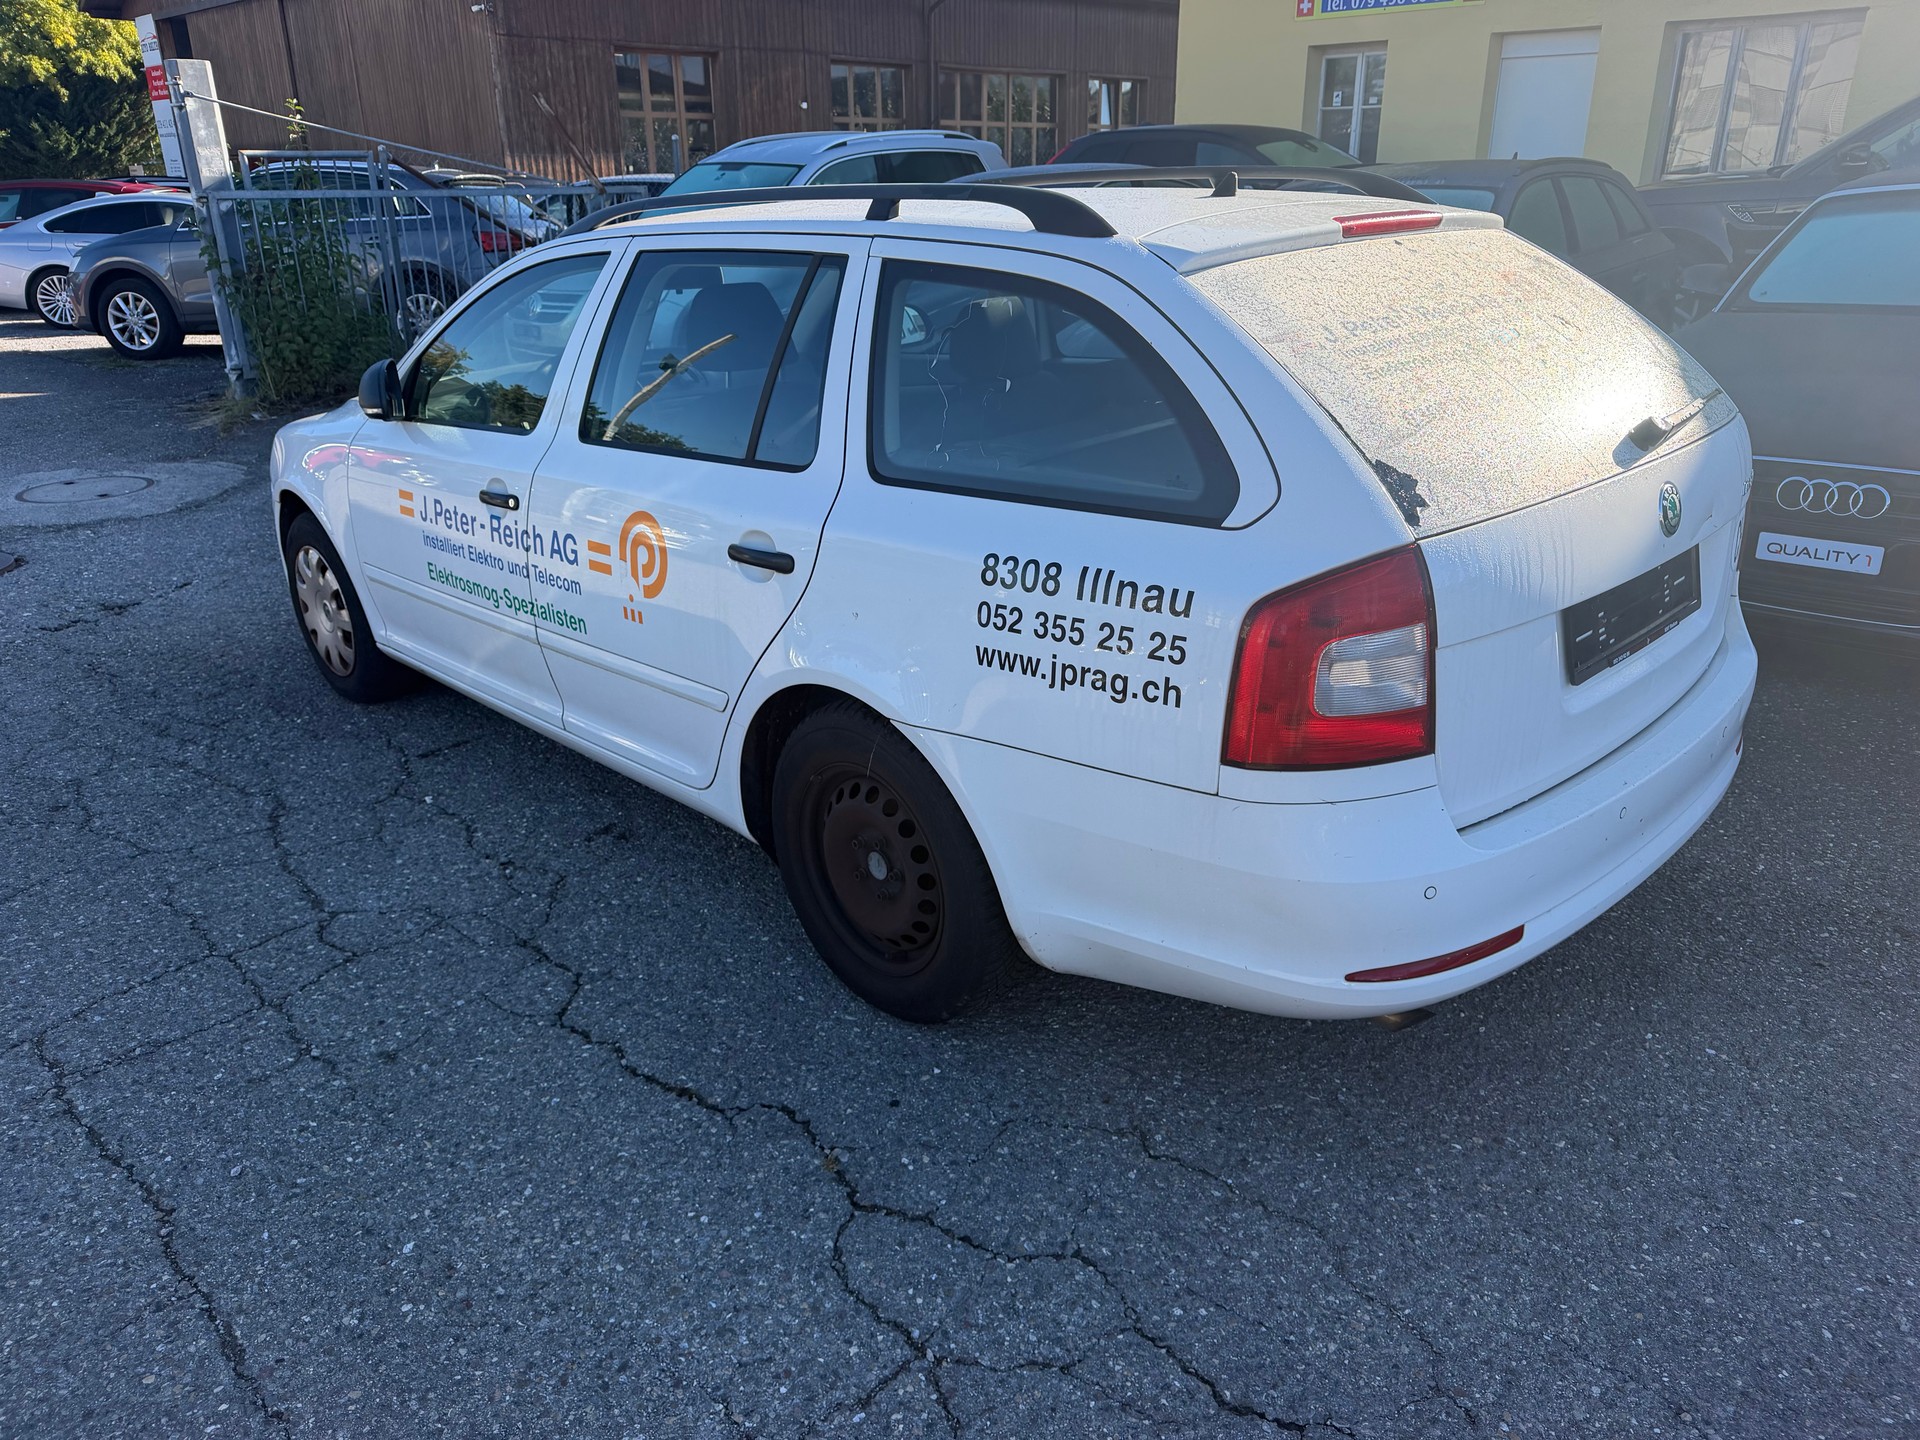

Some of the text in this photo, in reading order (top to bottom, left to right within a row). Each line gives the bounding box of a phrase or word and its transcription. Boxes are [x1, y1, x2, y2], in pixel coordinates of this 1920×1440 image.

[420, 495, 477, 537] J.Peter
[490, 514, 545, 557] Reich
[550, 530, 579, 567] AG
[422, 530, 582, 595] installiert Elektro und Telecom
[1766, 542, 1872, 567] QUALITY 1
[426, 561, 588, 635] Elektrosmog-Spezialisten
[980, 552, 1196, 619] 8308 Illnau
[976, 600, 1187, 665] 052 355 25 25
[975, 645, 1182, 709] www.jprag.ch
